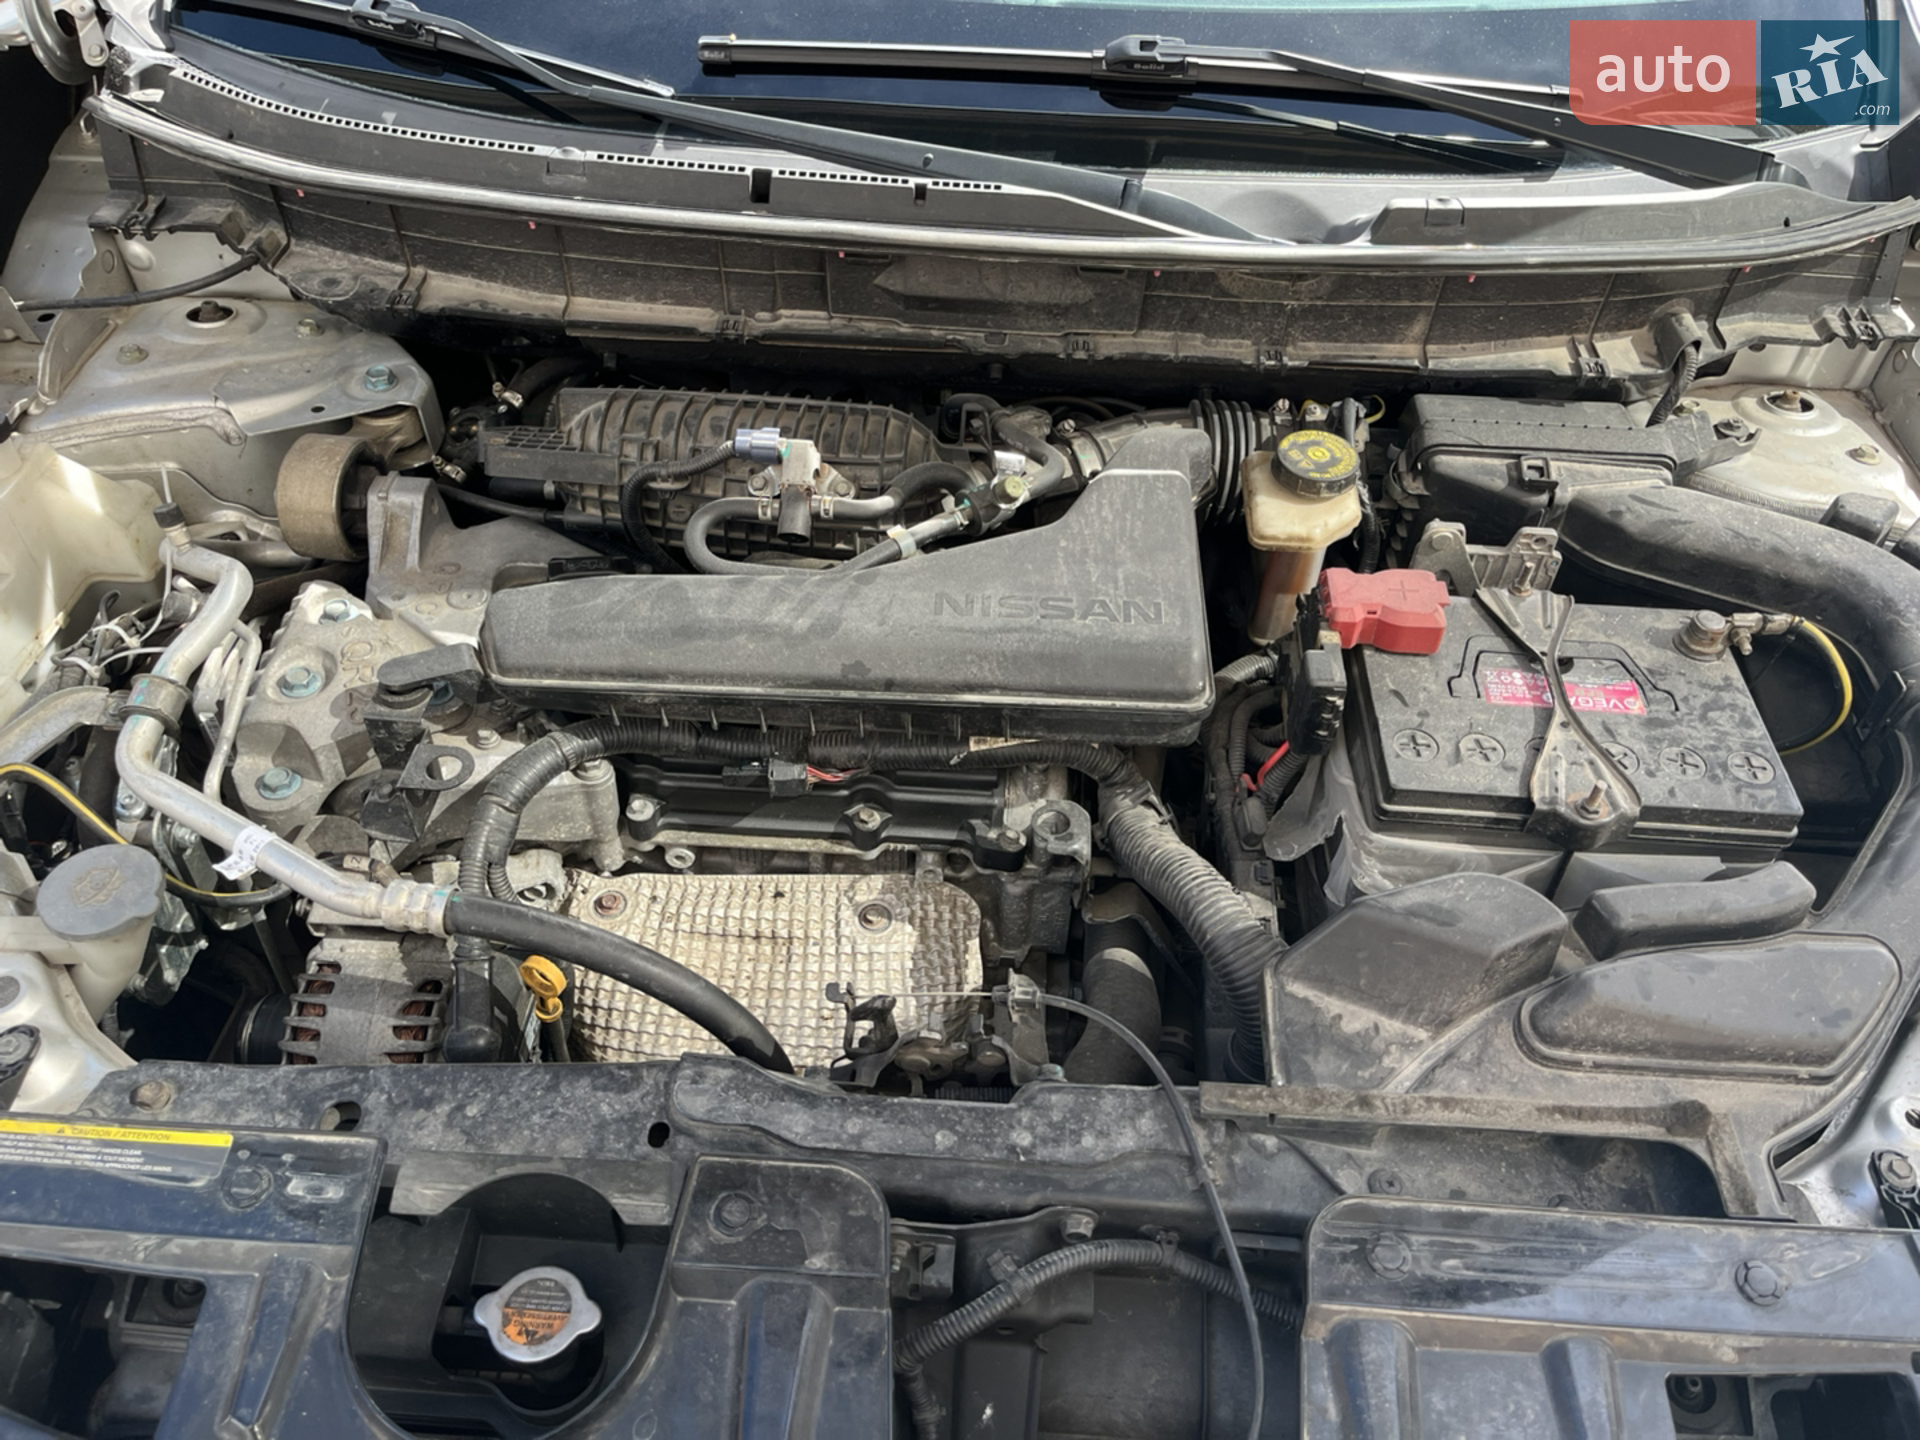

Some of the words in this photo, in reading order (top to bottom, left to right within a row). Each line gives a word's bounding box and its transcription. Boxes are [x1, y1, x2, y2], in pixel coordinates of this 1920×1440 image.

[1133, 63, 1165, 71] Solid
[933, 592, 1164, 625] NISSAN
[71, 1126, 111, 1138] CAUTION
[120, 1130, 171, 1141] ATTENTION
[513, 1320, 554, 1330] WARNING
